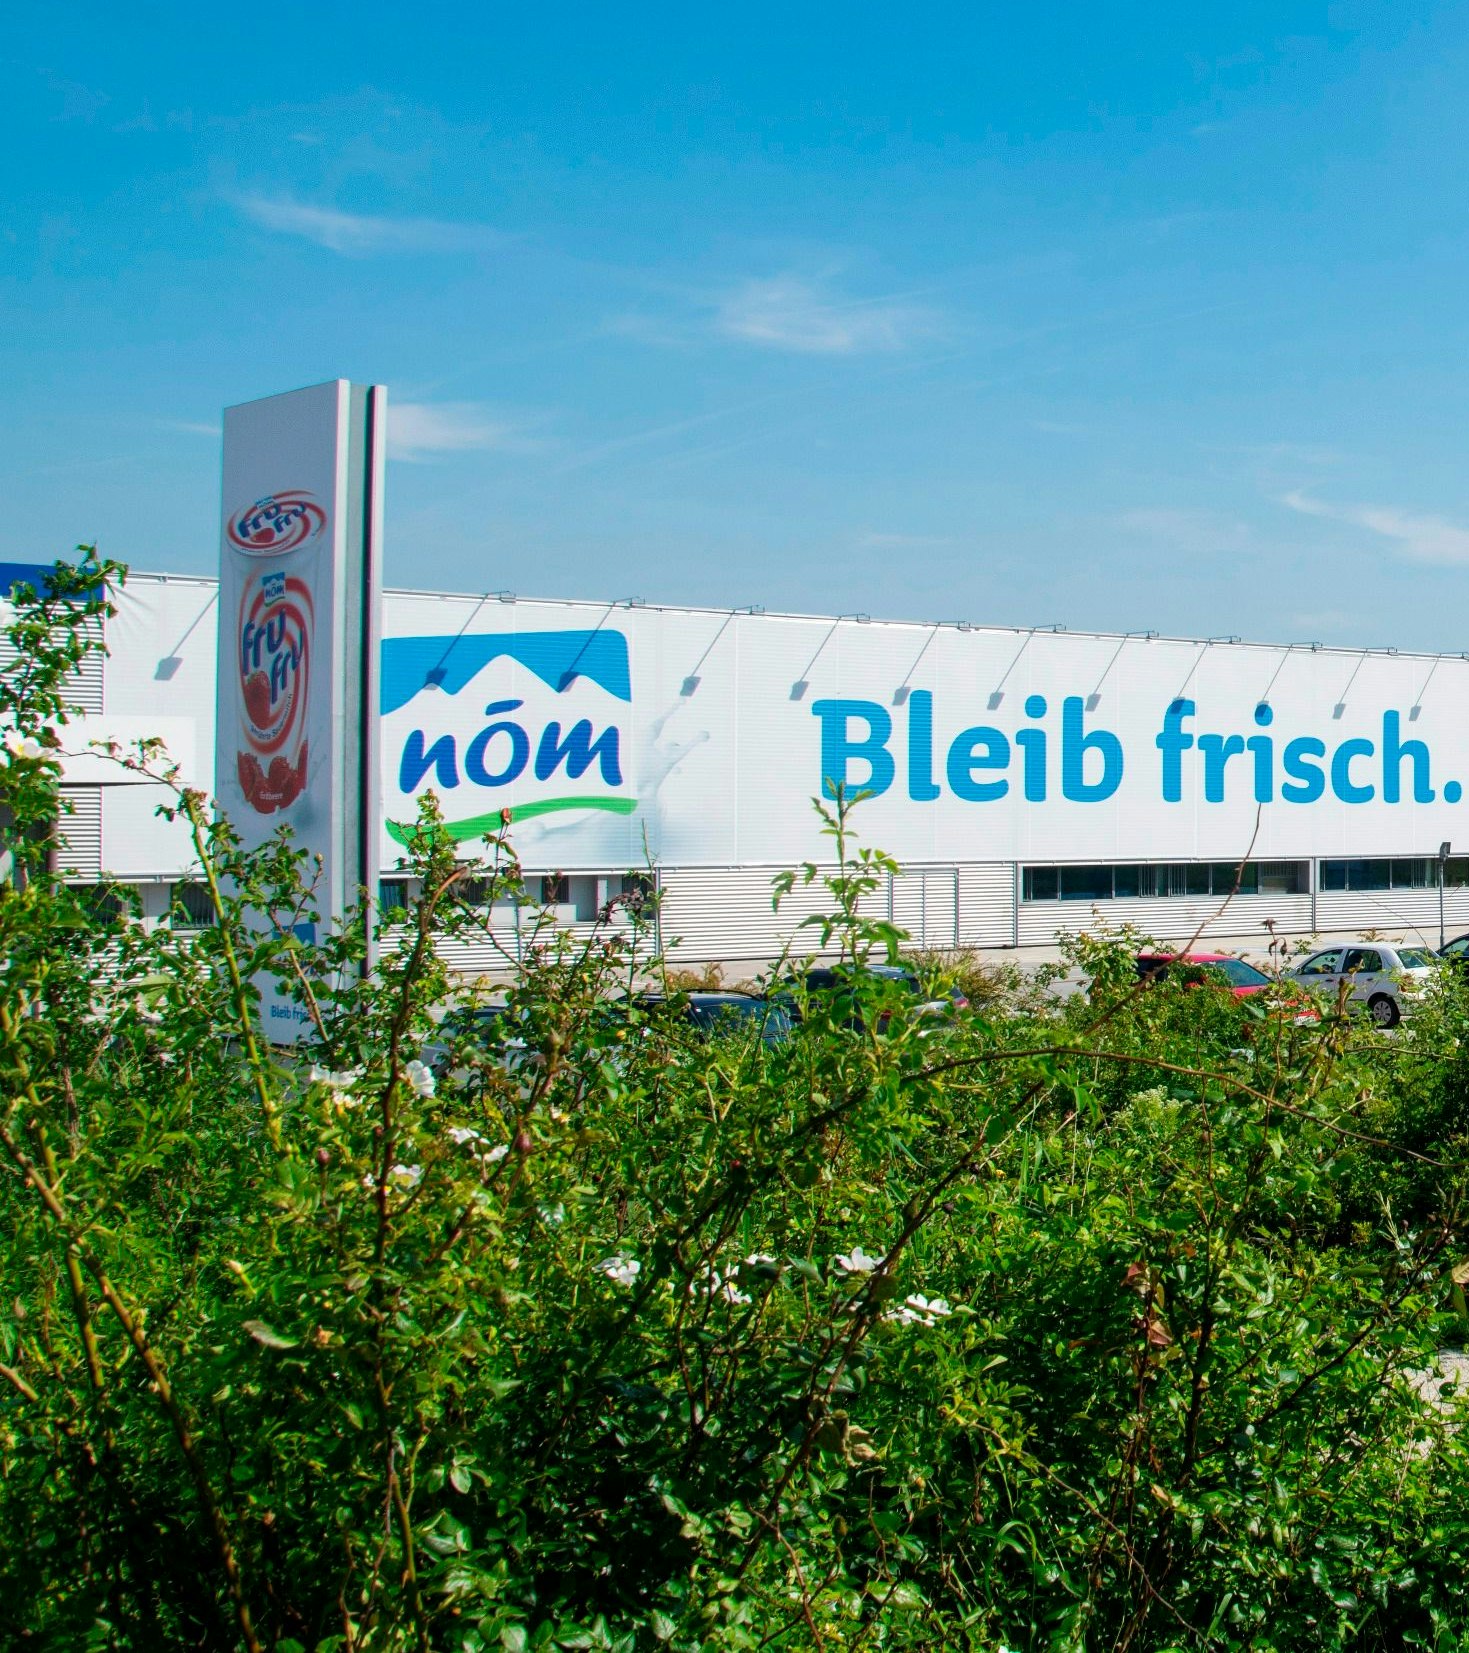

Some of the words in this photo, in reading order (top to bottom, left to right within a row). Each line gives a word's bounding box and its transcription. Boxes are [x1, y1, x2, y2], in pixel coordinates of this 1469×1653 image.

[243, 608, 286, 677] fru
[811, 689, 1124, 803] Bleib
[1156, 699, 1463, 804] frisch.
[271, 1005, 292, 1019] Bleib
